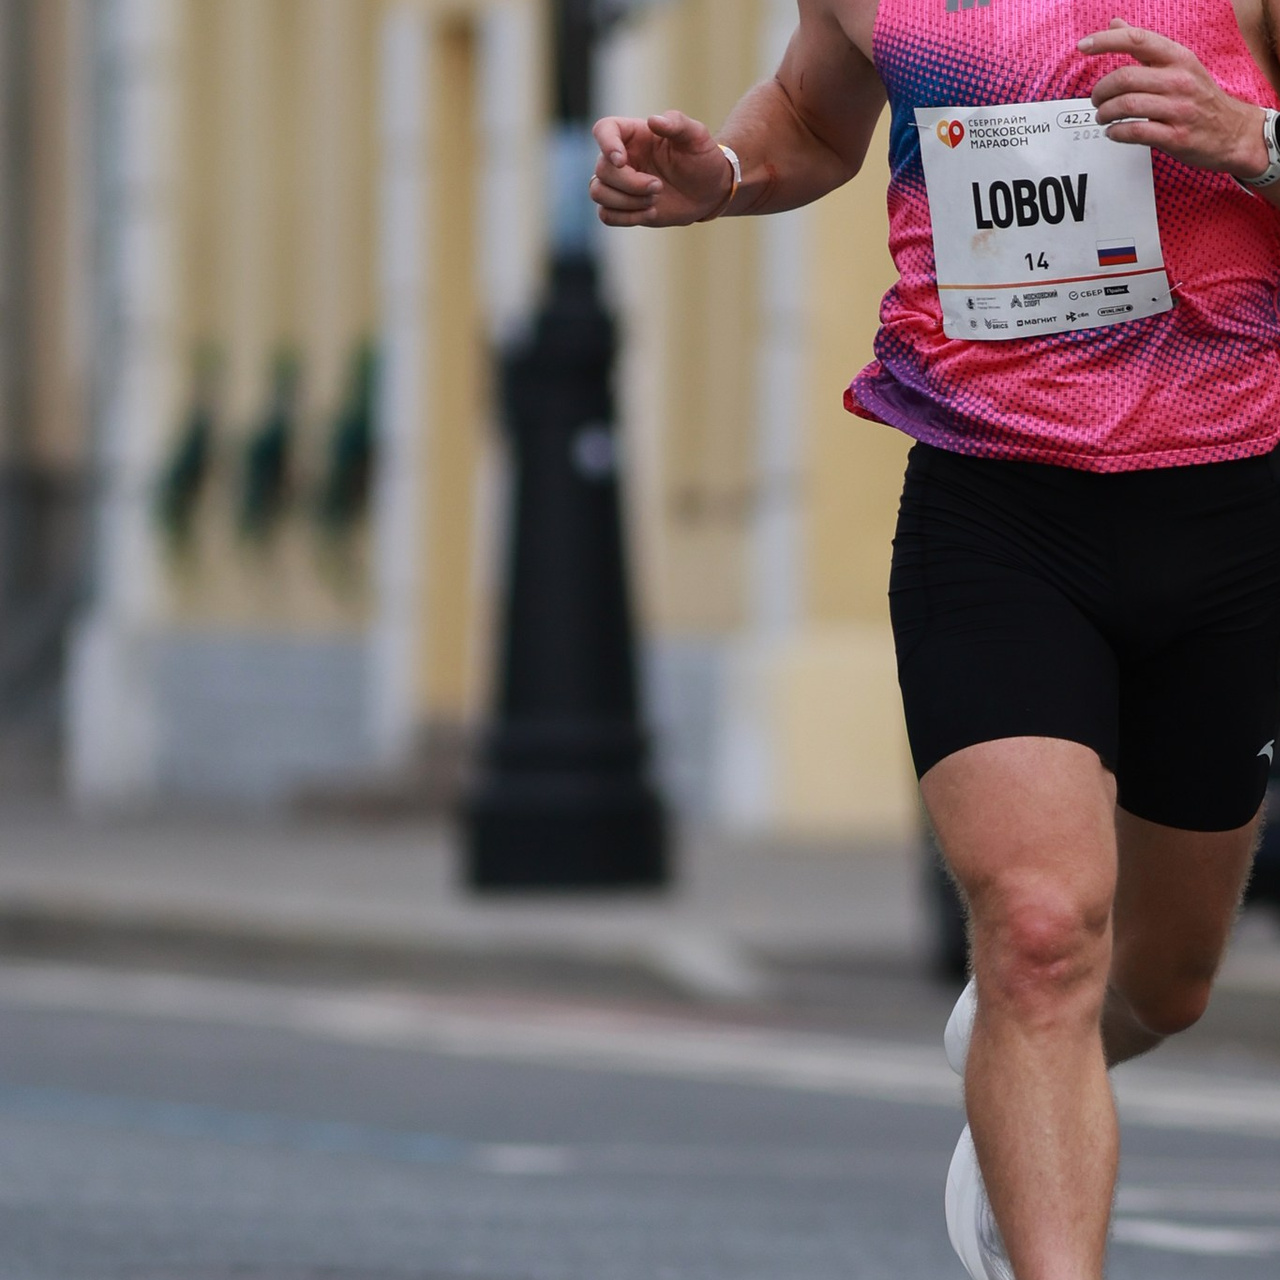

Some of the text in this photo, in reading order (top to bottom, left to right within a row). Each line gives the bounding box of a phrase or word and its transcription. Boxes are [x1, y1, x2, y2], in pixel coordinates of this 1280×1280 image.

[968, 115, 1027, 127] СБЕРПРАЙМ
[1064, 112, 1091, 125] 42,2
[969, 122, 1051, 139] МОСКОВСКИЙ
[970, 136, 1029, 150] МАРАФОН
[972, 173, 1088, 229] LOBOV
[1024, 251, 1049, 271] 14
[1023, 289, 1058, 300] МОСКОВСКИЙ
[1080, 288, 1103, 298] СБЕР
